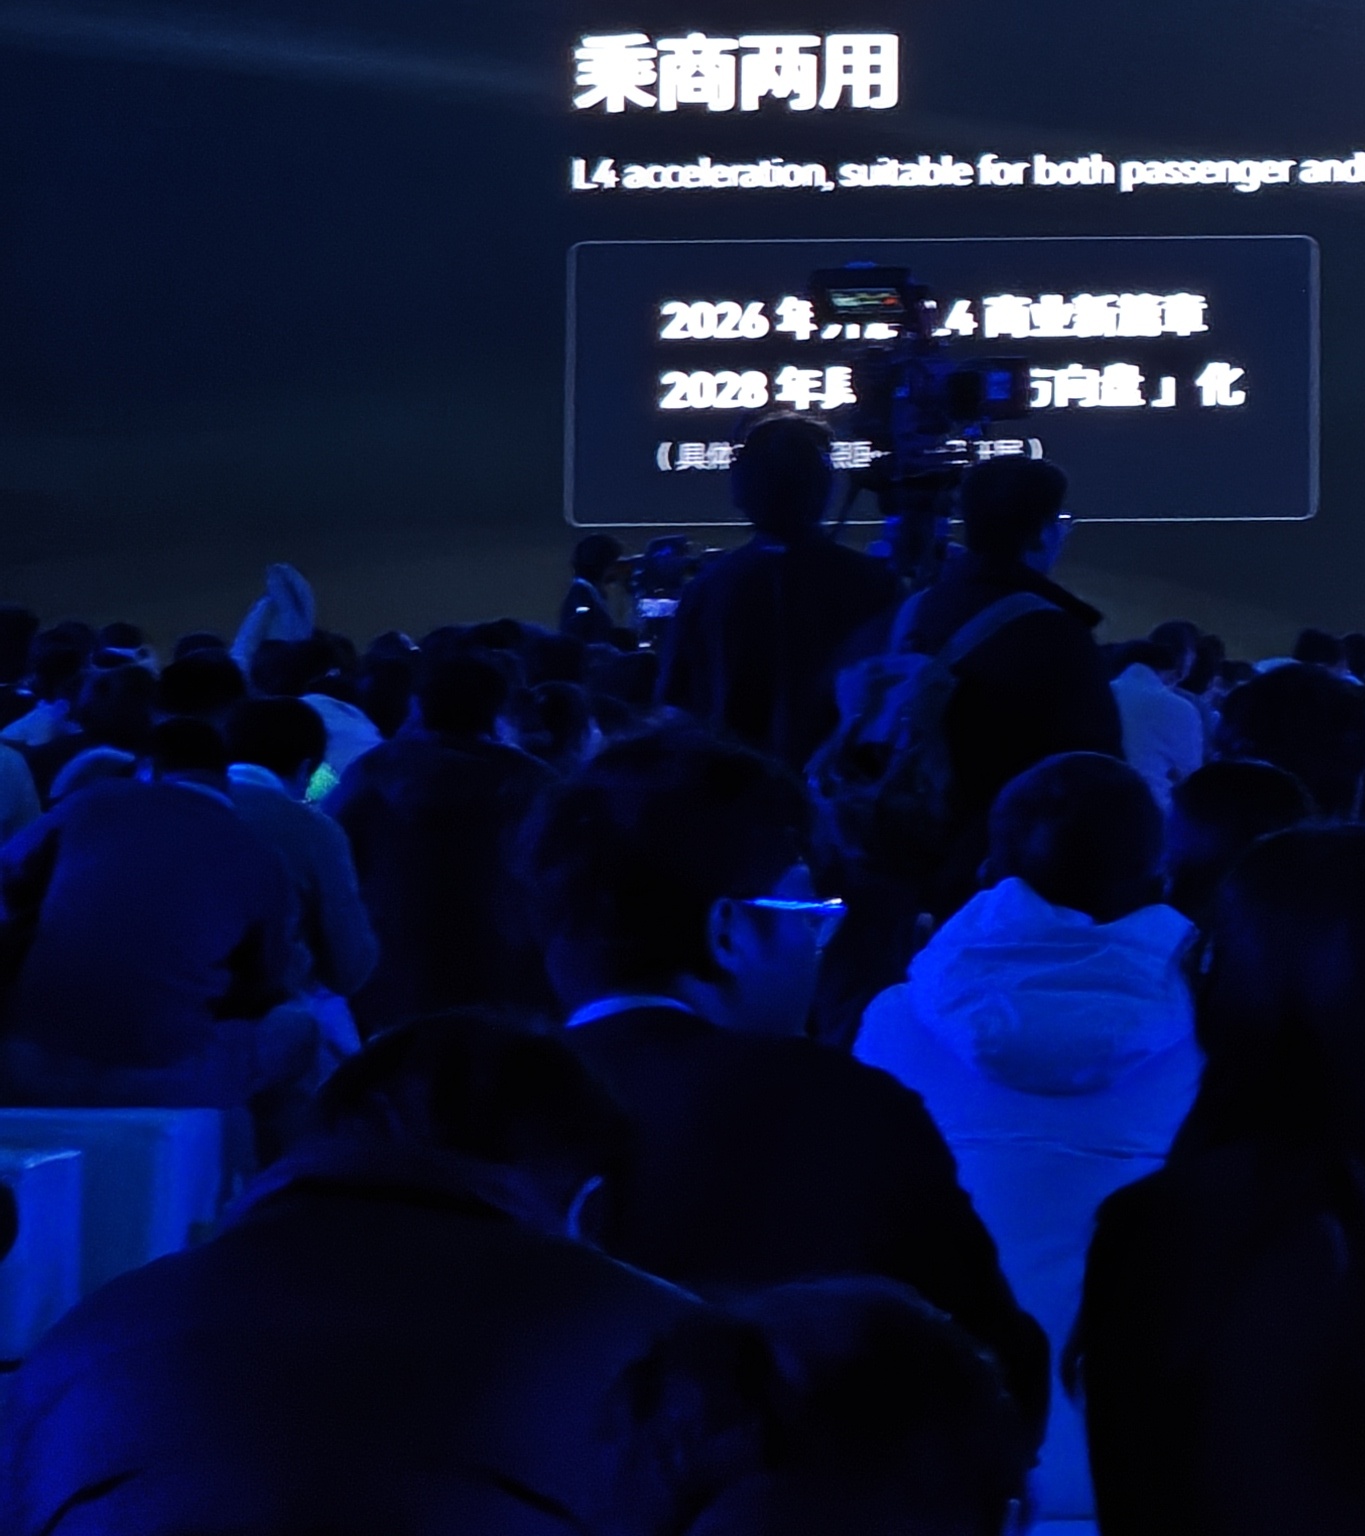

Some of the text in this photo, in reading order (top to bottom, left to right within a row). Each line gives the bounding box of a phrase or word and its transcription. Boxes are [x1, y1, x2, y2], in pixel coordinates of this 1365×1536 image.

[572, 31, 899, 114] 乘商两用
[571, 158, 619, 190] L4
[623, 156, 836, 192] acceleration,
[838, 154, 973, 188] suitable
[976, 152, 1031, 186] for
[1033, 152, 1116, 186] both
[1119, 159, 1297, 193] passenger
[659, 300, 770, 340] 2026
[931, 300, 979, 337] 4
[658, 368, 769, 410] 2028
